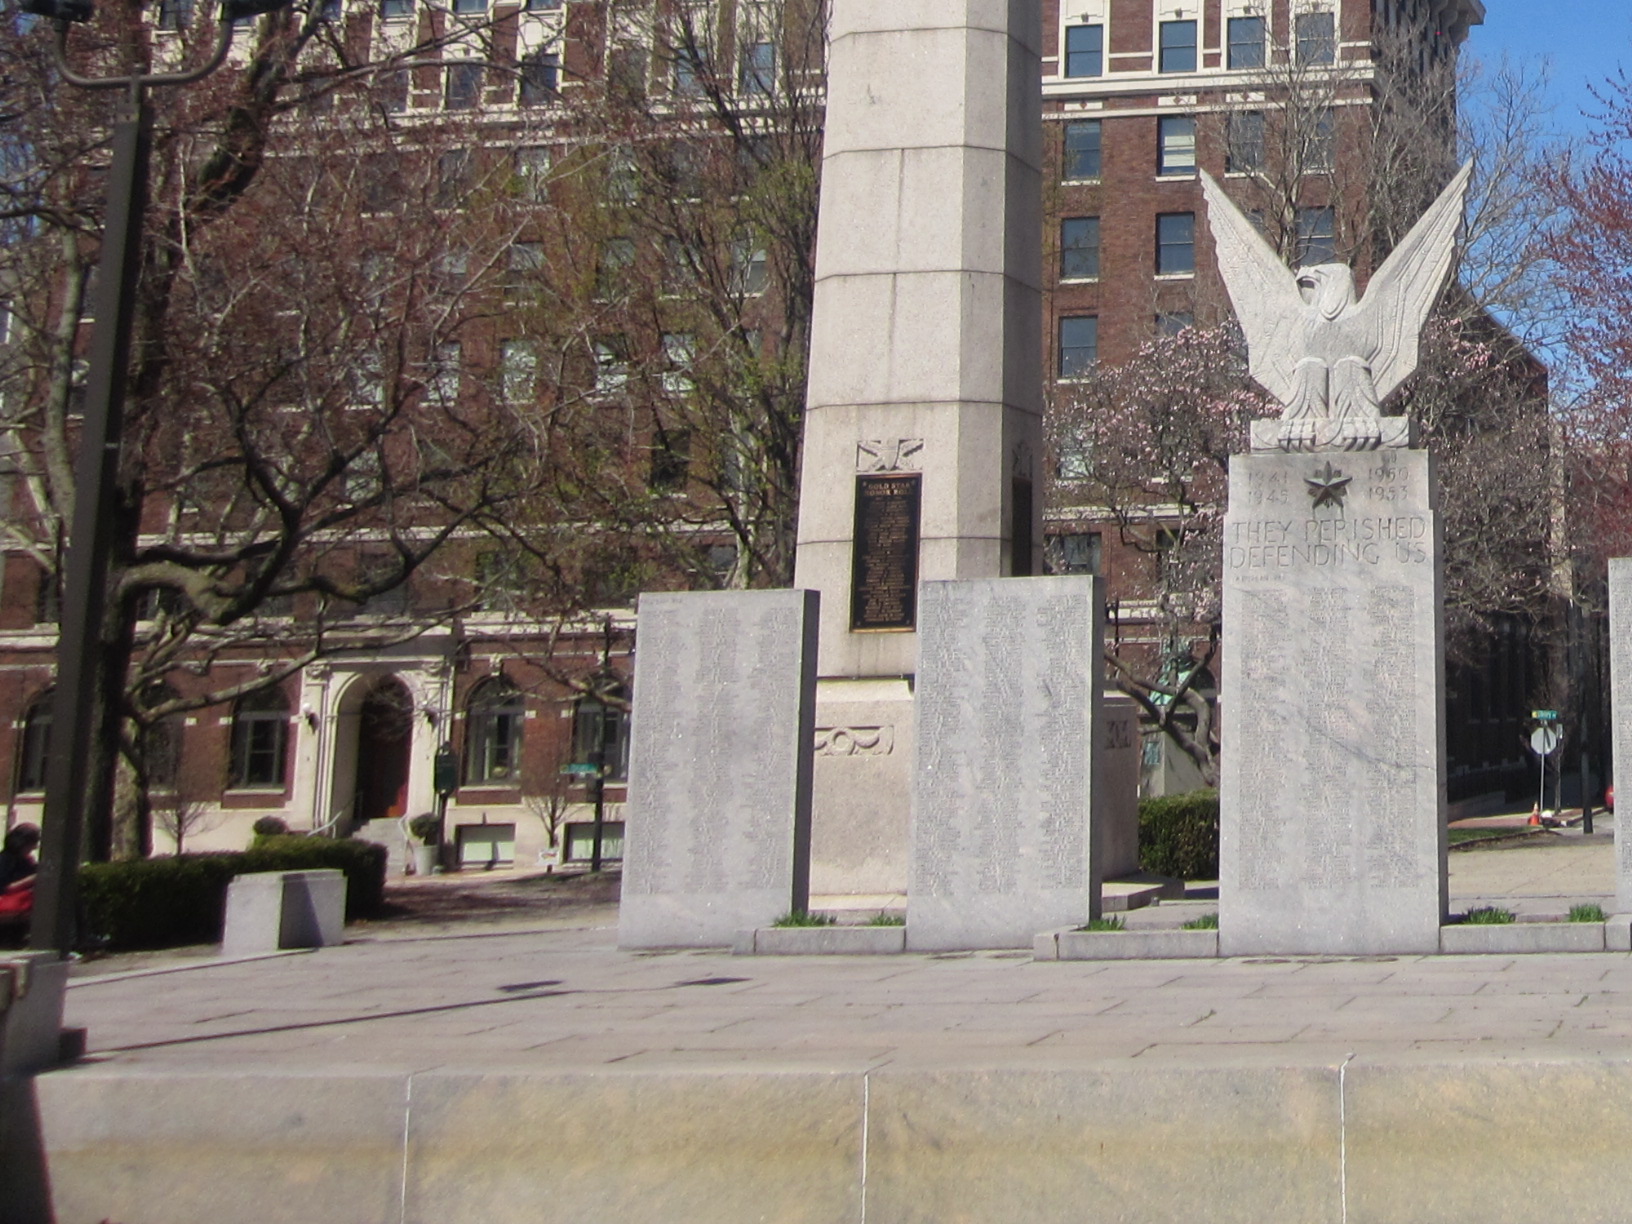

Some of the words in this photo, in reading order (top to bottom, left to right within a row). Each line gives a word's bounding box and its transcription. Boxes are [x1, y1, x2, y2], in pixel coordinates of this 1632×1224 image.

[1248, 471, 1288, 487] 1941
[1368, 467, 1409, 482] 1950
[1248, 490, 1288, 505] 1945
[1368, 486, 1408, 502] 1953
[1231, 519, 1292, 544] THEY
[1304, 516, 1426, 543] PERISHED
[1229, 541, 1380, 569] DEFENDING
[1395, 541, 1427, 564] US
